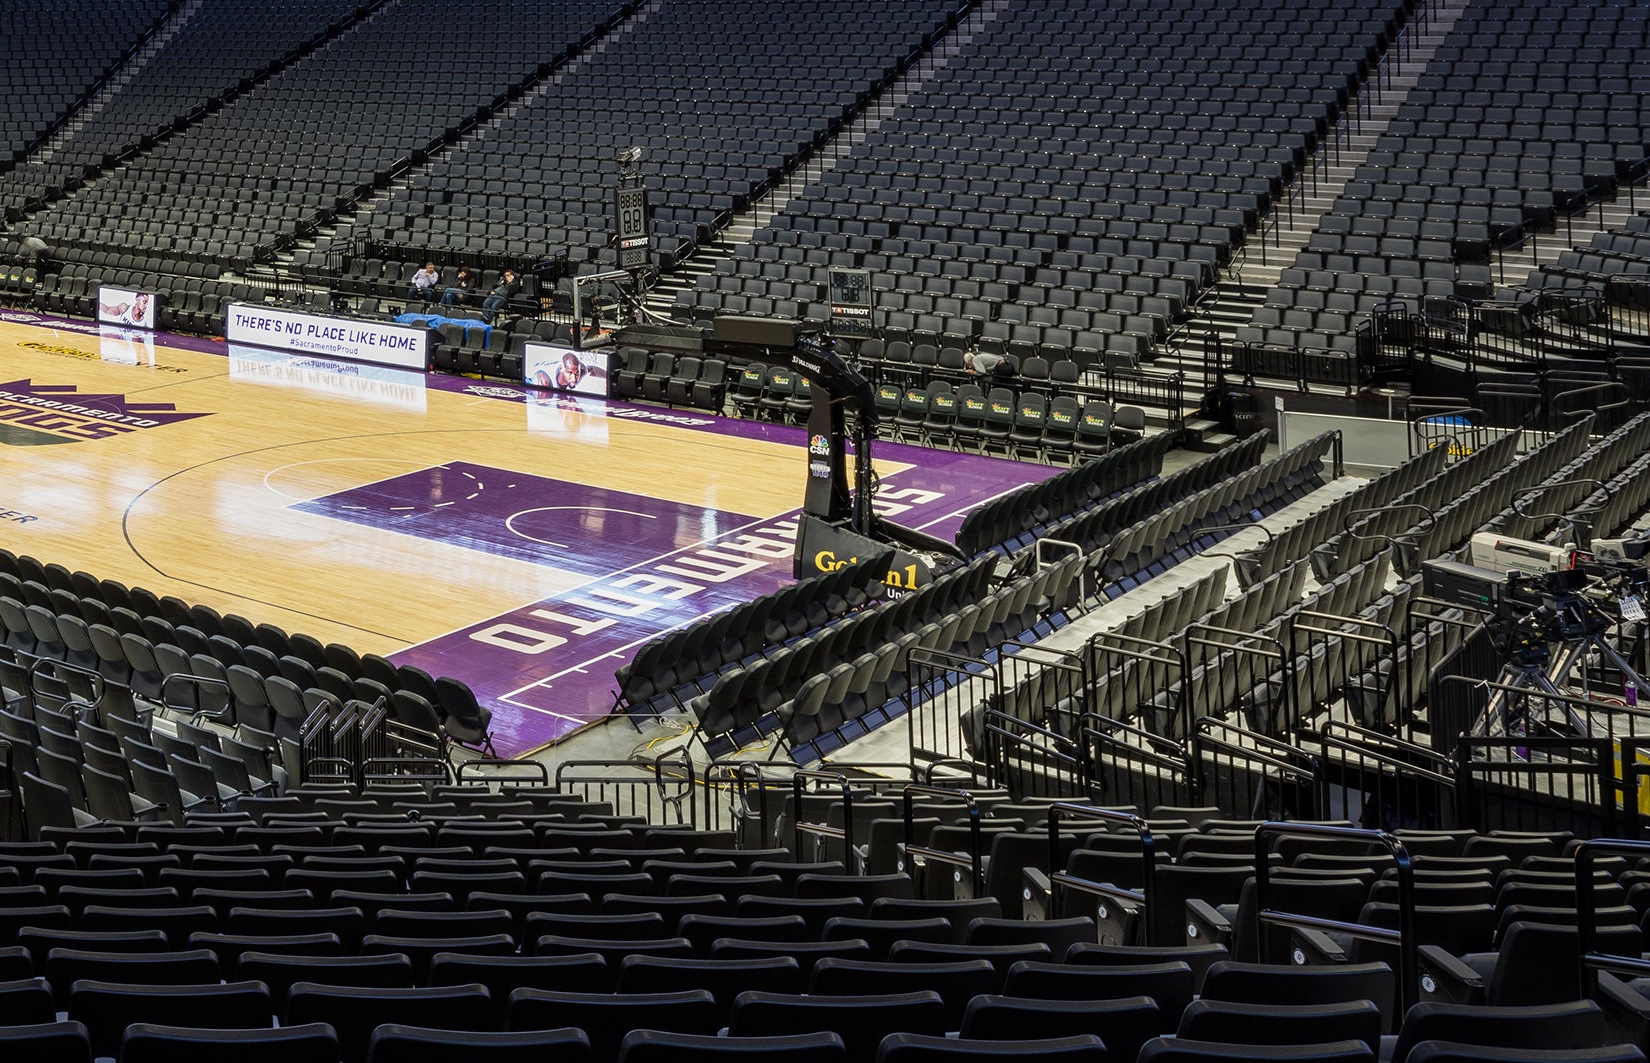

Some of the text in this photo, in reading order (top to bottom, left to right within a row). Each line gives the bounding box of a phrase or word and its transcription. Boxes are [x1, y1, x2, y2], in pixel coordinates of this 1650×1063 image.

[630, 237, 648, 246] TISSOT
[235, 314, 417, 351] THERE'S NO PLACE LIKE HOME
[290, 338, 359, 355] #SacramentoProud
[791, 355, 821, 374] SPALDING
[809, 446, 830, 456] CSN
